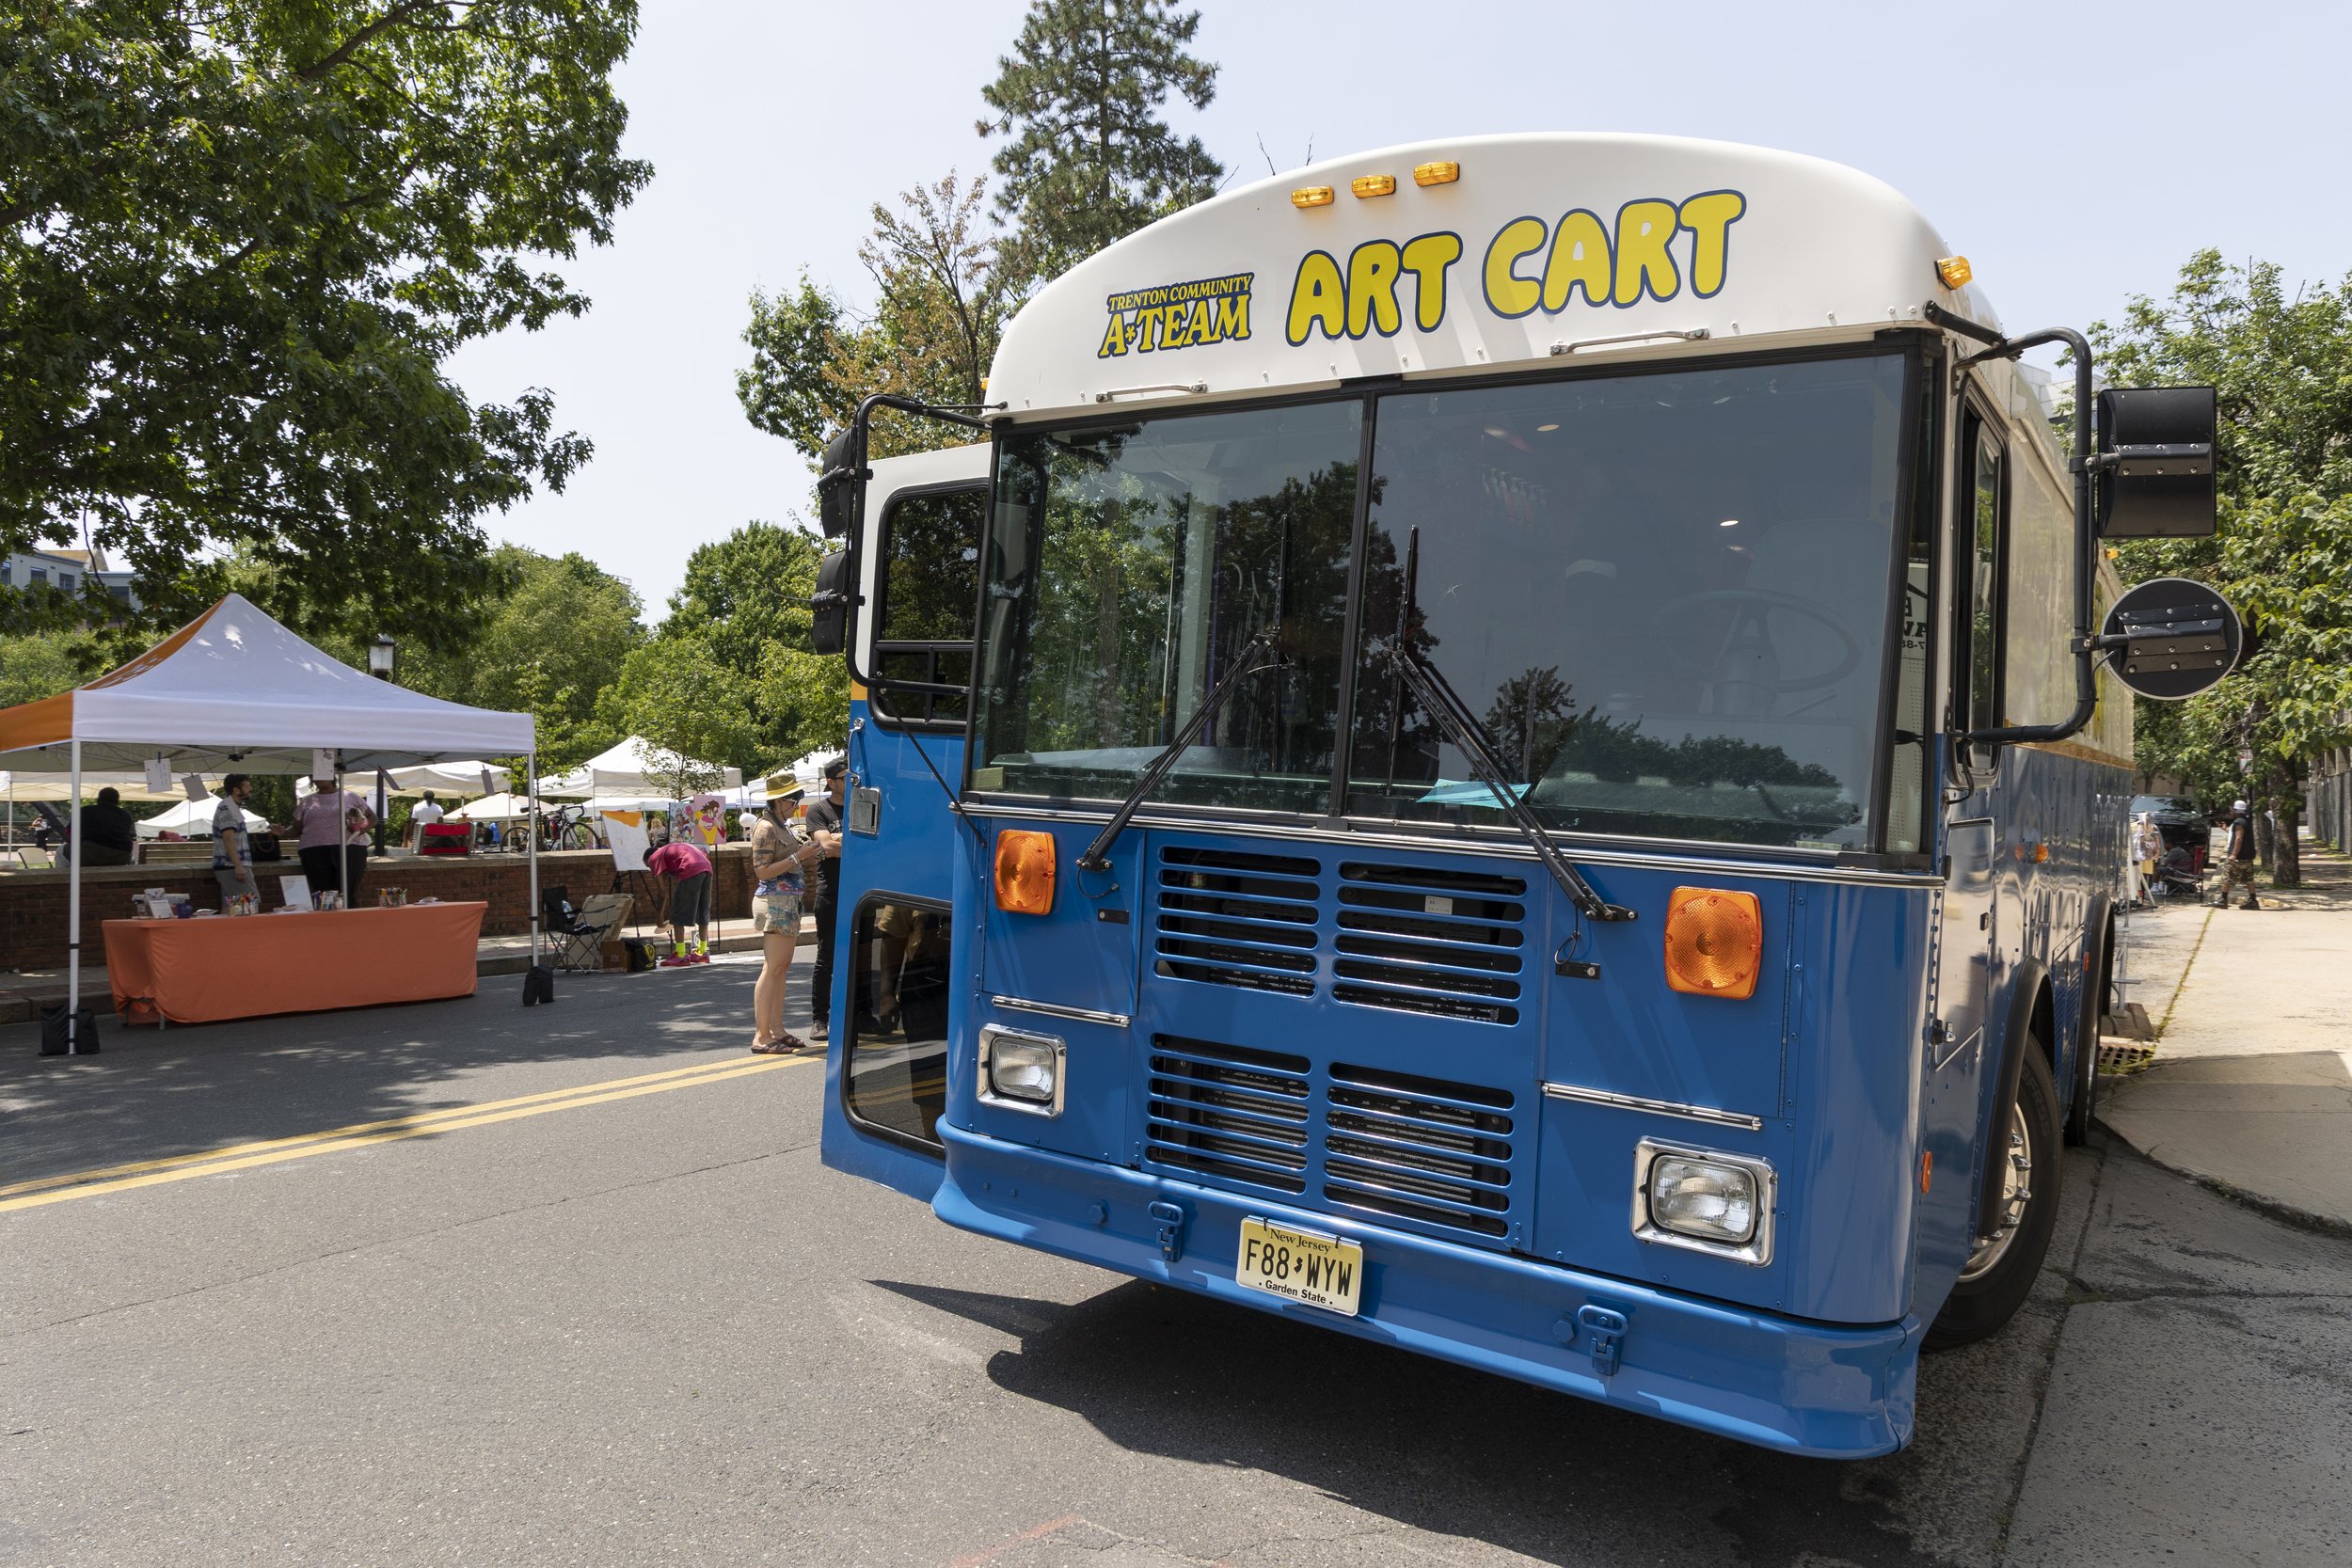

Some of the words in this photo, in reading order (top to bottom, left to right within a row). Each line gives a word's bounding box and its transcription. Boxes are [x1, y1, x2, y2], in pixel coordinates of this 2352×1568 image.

[1285, 230, 1463, 347] ART
[1482, 189, 1746, 320] CART
[1108, 287, 1169, 312] TRENTON
[1169, 275, 1252, 301] COMMUNITY
[1270, 1227, 1295, 1244] New
[1296, 1235, 1331, 1256] Jersey
[1246, 1238, 1290, 1280] F88
[1306, 1253, 1353, 1297] WYW
[1264, 1279, 1298, 1296] Garden
[1301, 1289, 1327, 1304] State
